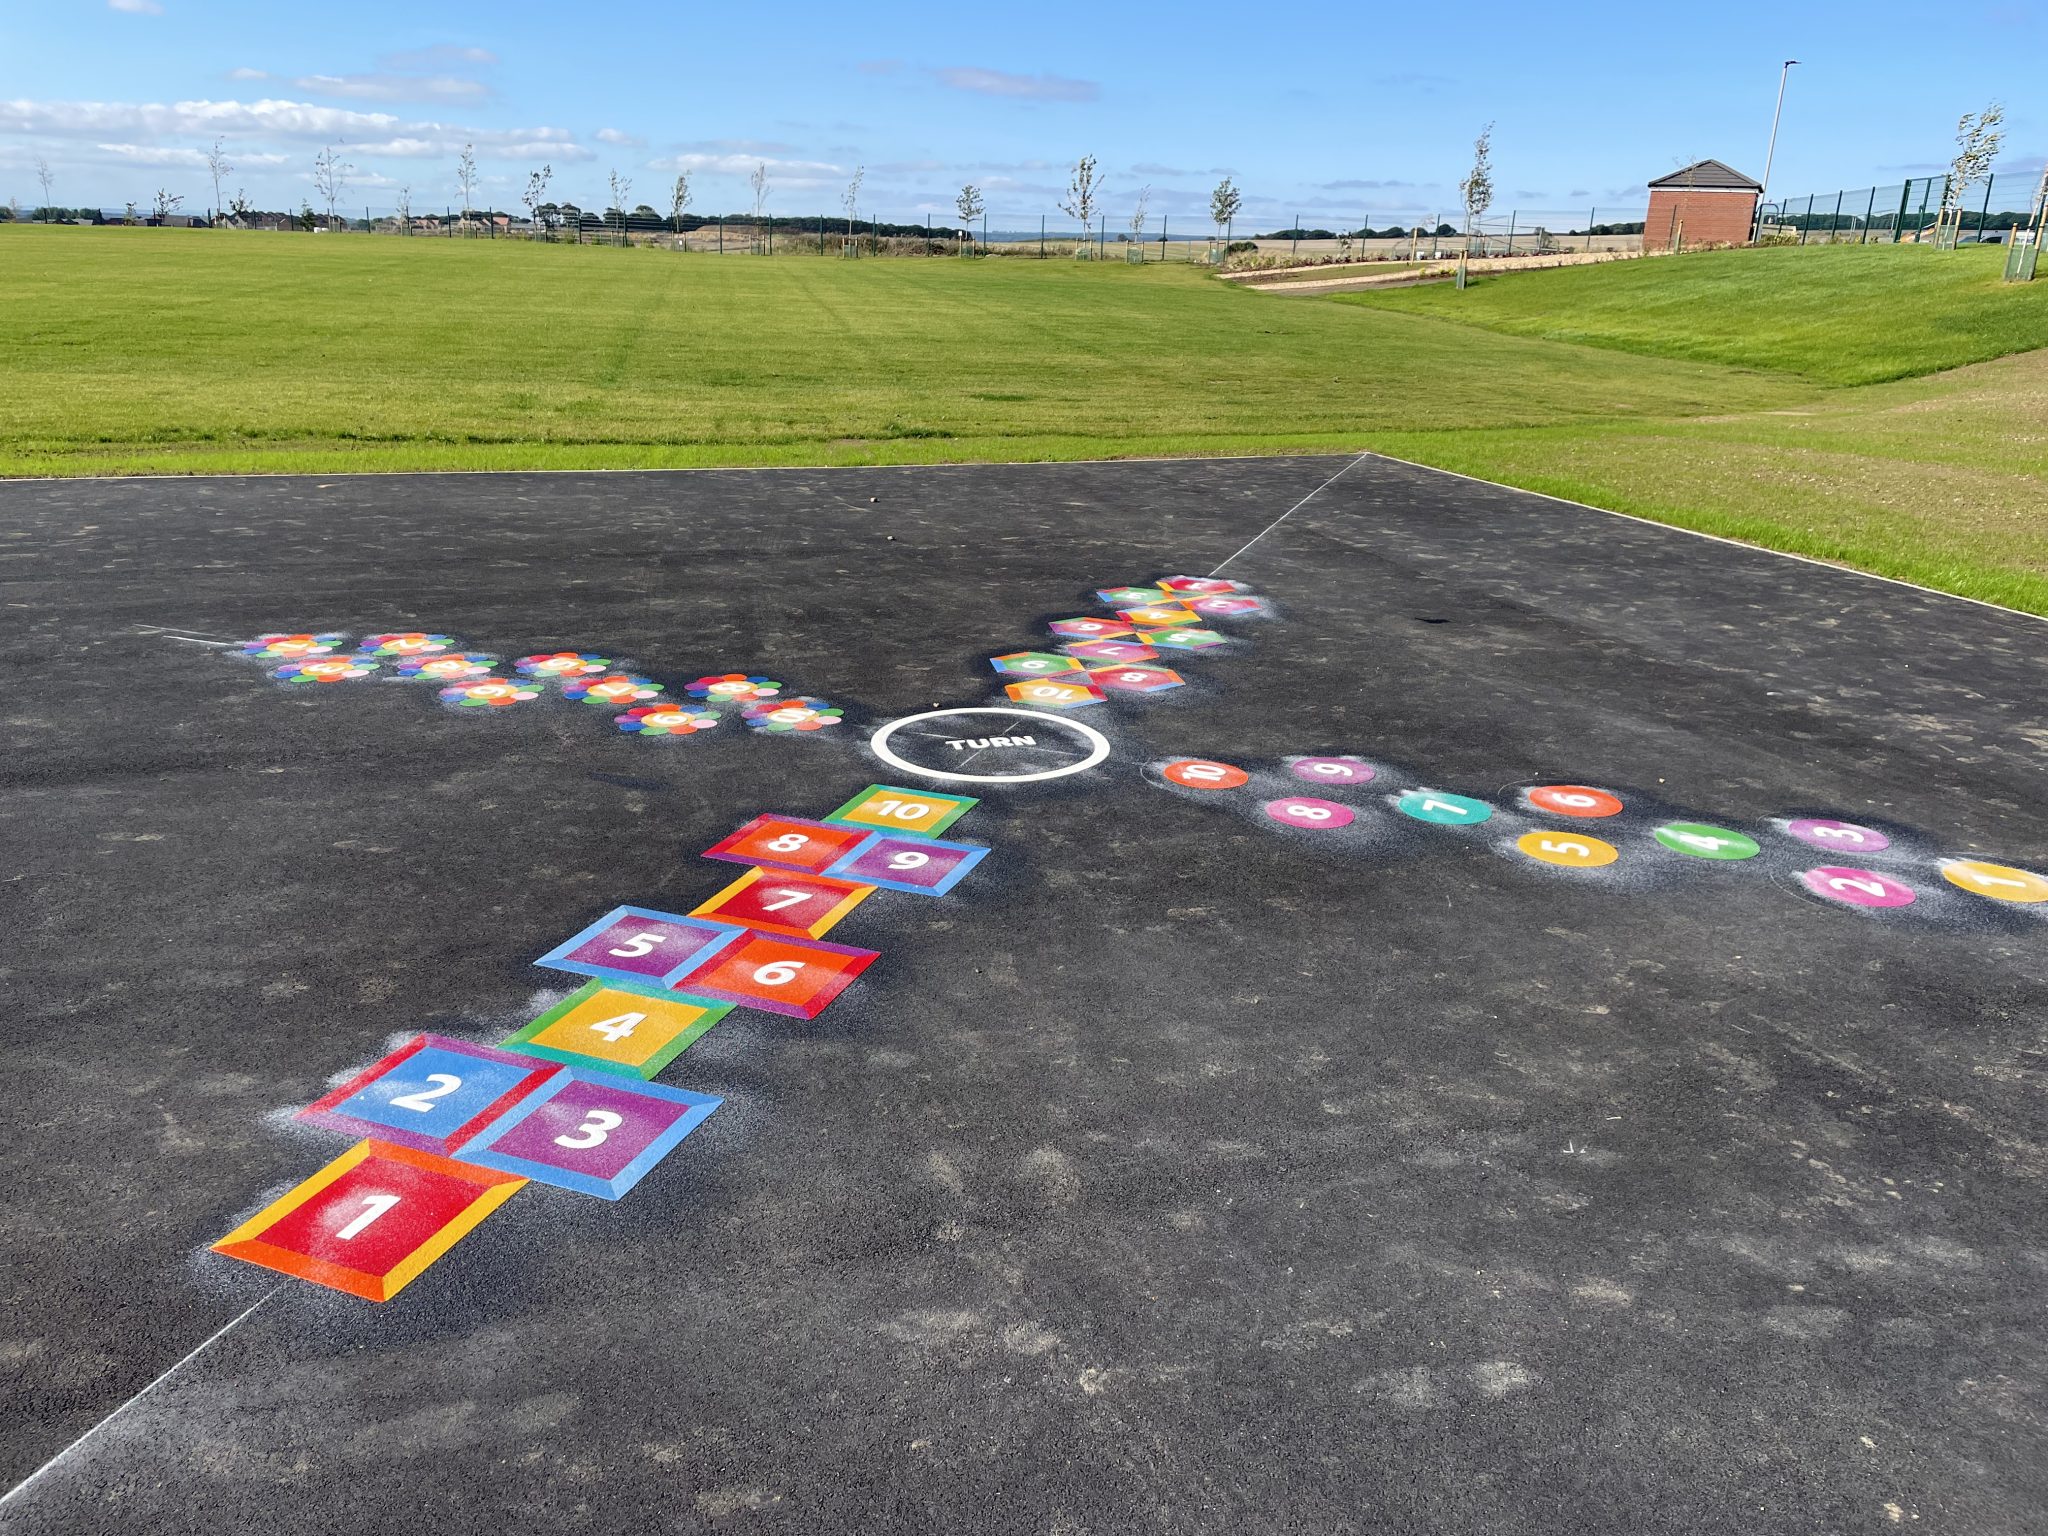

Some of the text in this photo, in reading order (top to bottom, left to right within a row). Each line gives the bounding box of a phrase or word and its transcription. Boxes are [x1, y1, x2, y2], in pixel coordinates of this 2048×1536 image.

[1208, 600, 1232, 608] 2
[1077, 623, 1103, 631] 6
[393, 639, 425, 648] 2
[1167, 633, 1192, 642] 5
[1098, 647, 1125, 655] 7
[1021, 660, 1049, 668] 9
[1120, 672, 1148, 682] 8
[472, 686, 506, 696] 6
[599, 684, 630, 694] 7
[718, 683, 750, 692] 8
[1033, 687, 1073, 699] 10
[653, 713, 686, 725] 9
[770, 707, 816, 723] 10
[945, 735, 1037, 750] TURN
[1181, 764, 1226, 782] 10
[1313, 763, 1353, 777] 9
[1422, 799, 1468, 815] 7
[1551, 793, 1596, 808] 6
[877, 800, 930, 820] 10
[1287, 806, 1332, 820] 8
[1813, 826, 1864, 843] 3
[767, 833, 810, 853] 8
[1541, 840, 1590, 857] 5
[1679, 834, 1729, 851] 4
[888, 850, 930, 870] 9
[1829, 877, 1886, 897] 2
[1972, 874, 2026, 888] 1
[761, 890, 813, 911] 7
[609, 932, 667, 958] 5
[753, 960, 805, 986] 6
[590, 1012, 648, 1042] 4
[389, 1074, 462, 1112] 2
[554, 1110, 623, 1150] 3
[335, 1194, 402, 1241] 1
